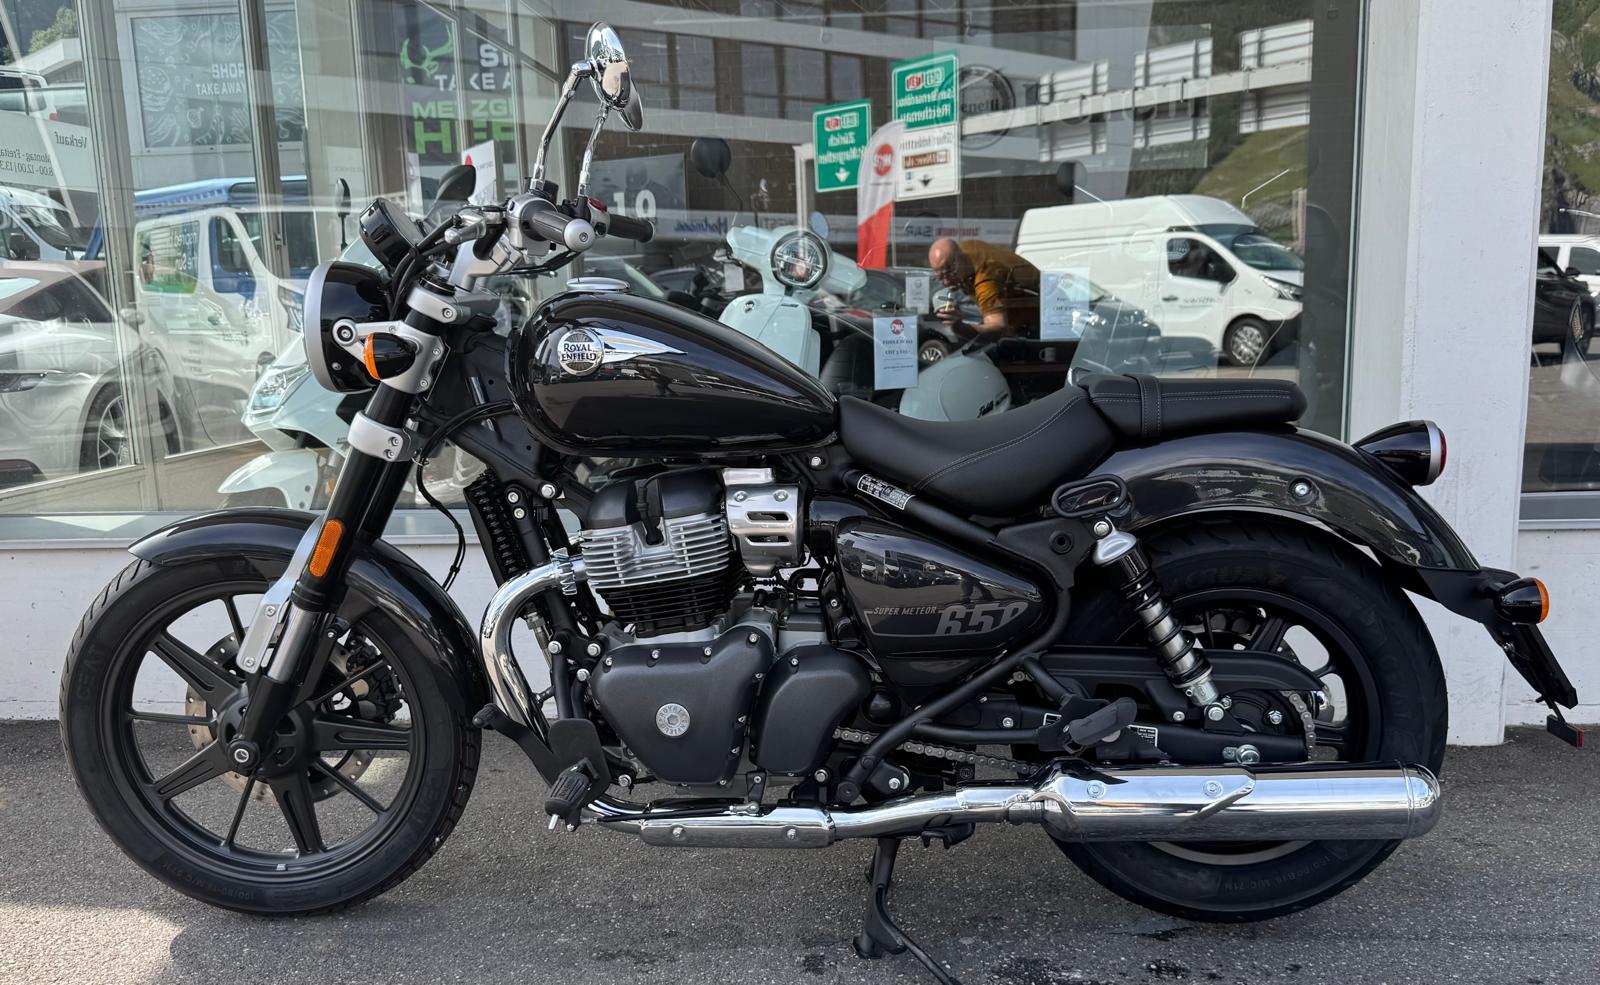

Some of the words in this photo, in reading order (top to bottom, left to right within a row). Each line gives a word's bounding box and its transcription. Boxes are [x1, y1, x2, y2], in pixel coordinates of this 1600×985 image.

[195, 83, 220, 96] TAKE
[221, 80, 247, 96] AWAY
[960, 99, 1000, 113] enelli
[563, 343, 593, 352] ROYAL
[561, 352, 597, 362] ENFIELD
[873, 606, 899, 616] SUPER
[901, 606, 937, 616] METEOR
[934, 601, 1029, 636] 650
